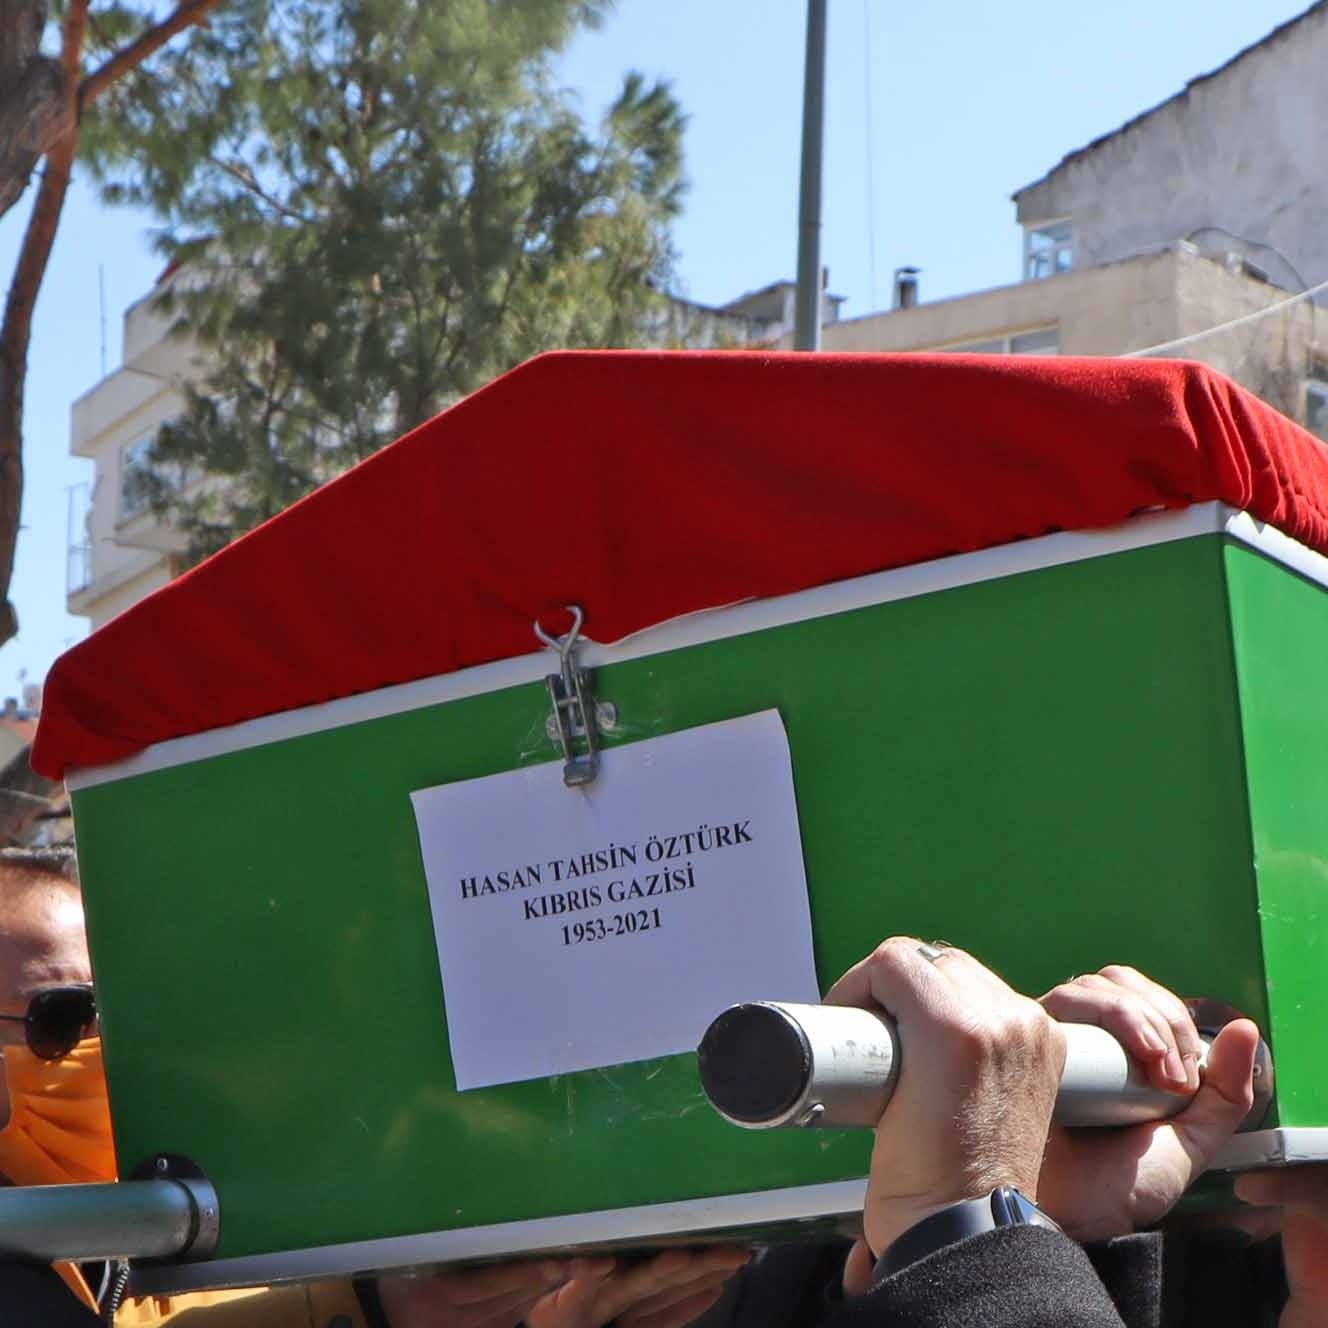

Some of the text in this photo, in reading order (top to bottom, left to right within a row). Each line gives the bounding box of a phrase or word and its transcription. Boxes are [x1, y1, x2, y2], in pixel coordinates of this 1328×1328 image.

[459, 820, 754, 900] HASAN TAHSİN ÖZTÜRK
[522, 861, 696, 921] KIBRIS GAZİSİ
[560, 907, 663, 946] 1953-2021
